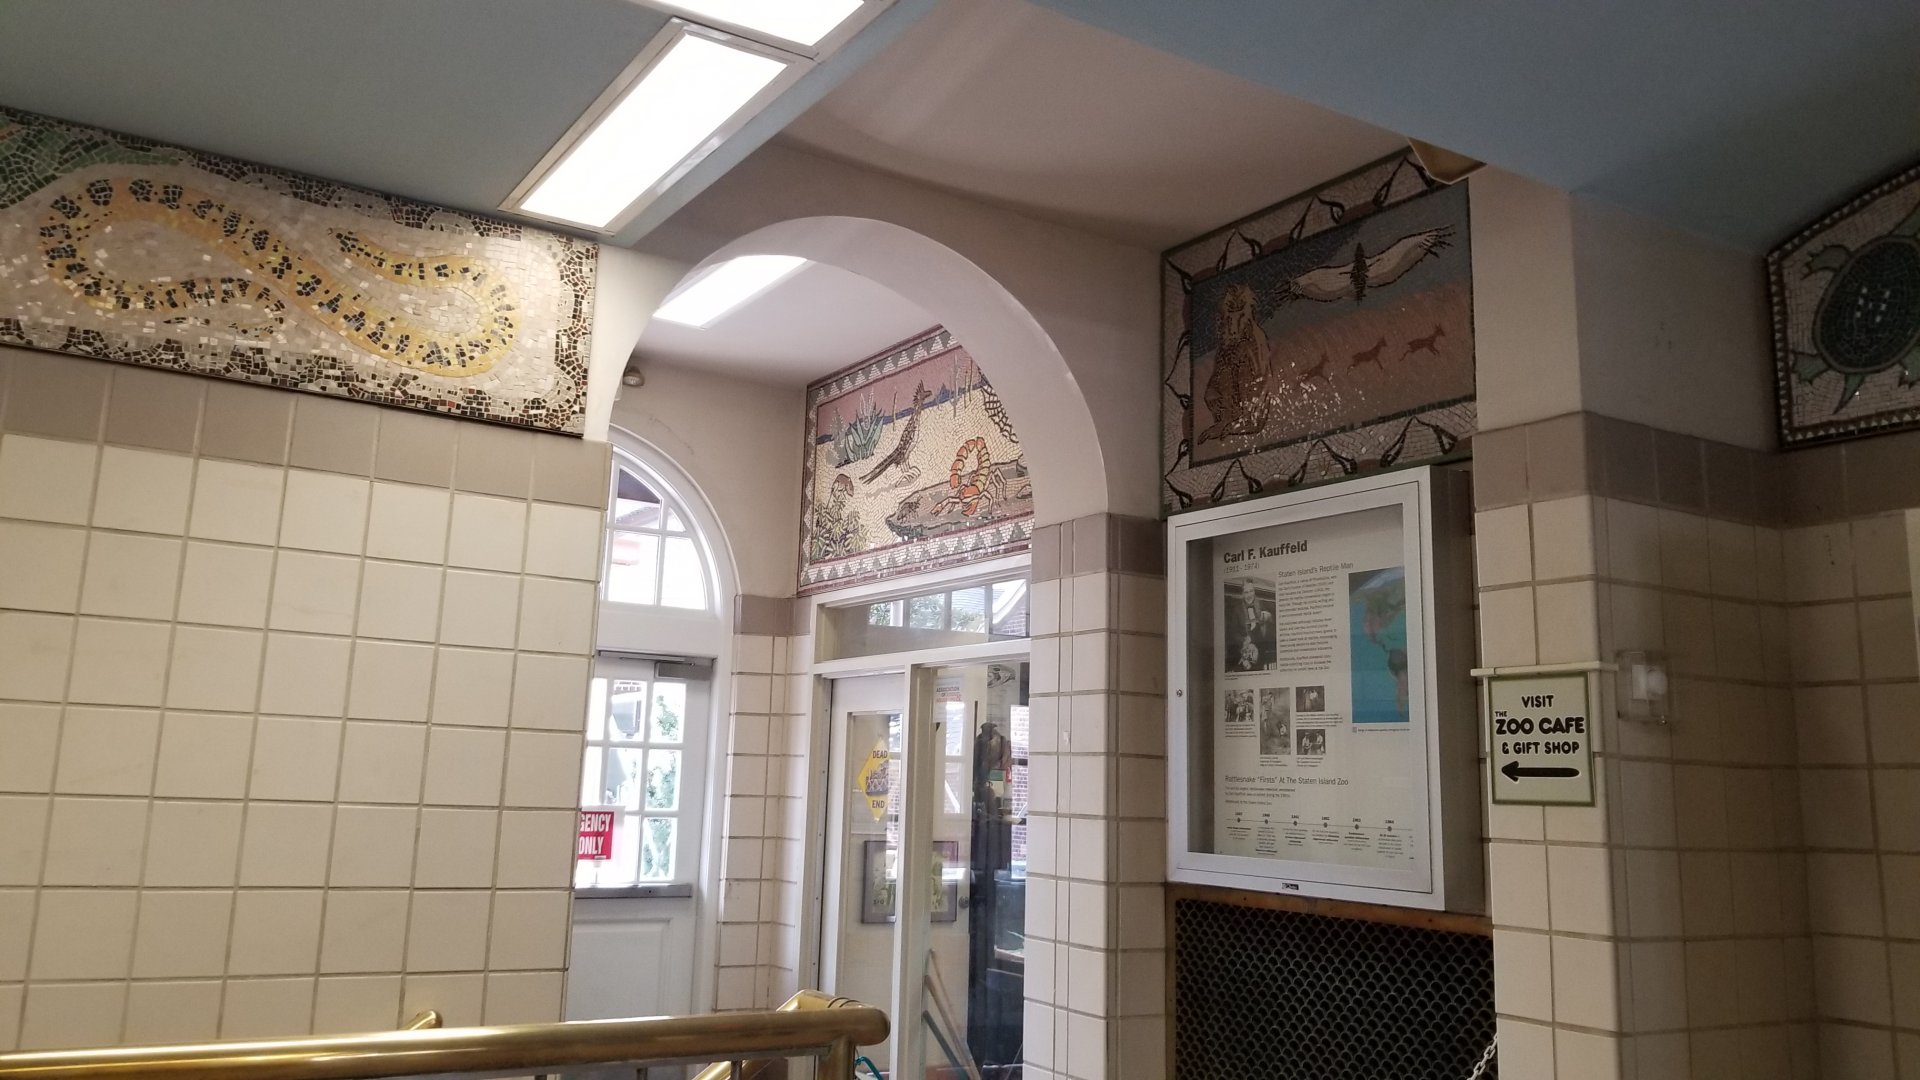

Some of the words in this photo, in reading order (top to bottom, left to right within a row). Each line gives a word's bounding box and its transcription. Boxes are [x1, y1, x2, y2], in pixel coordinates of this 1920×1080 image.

[1223, 550, 1244, 564] Carl
[1247, 548, 1256, 560] F.
[1259, 540, 1308, 559] Kauffeld
[1521, 695, 1554, 708] VISIT
[1495, 718, 1534, 735] ZOO
[1539, 717, 1585, 734] CAFE
[1502, 742, 1509, 754] &
[1513, 742, 1540, 754] GIFT
[1544, 741, 1580, 754] SHOP
[872, 750, 888, 759] DEAD
[1286, 776, 1297, 784] The
[1298, 776, 1317, 785] Staten
[1318, 777, 1336, 785] Island
[1337, 777, 1349, 786] Zoo
[872, 800, 884, 808] END
[579, 836, 604, 855] ONLY
